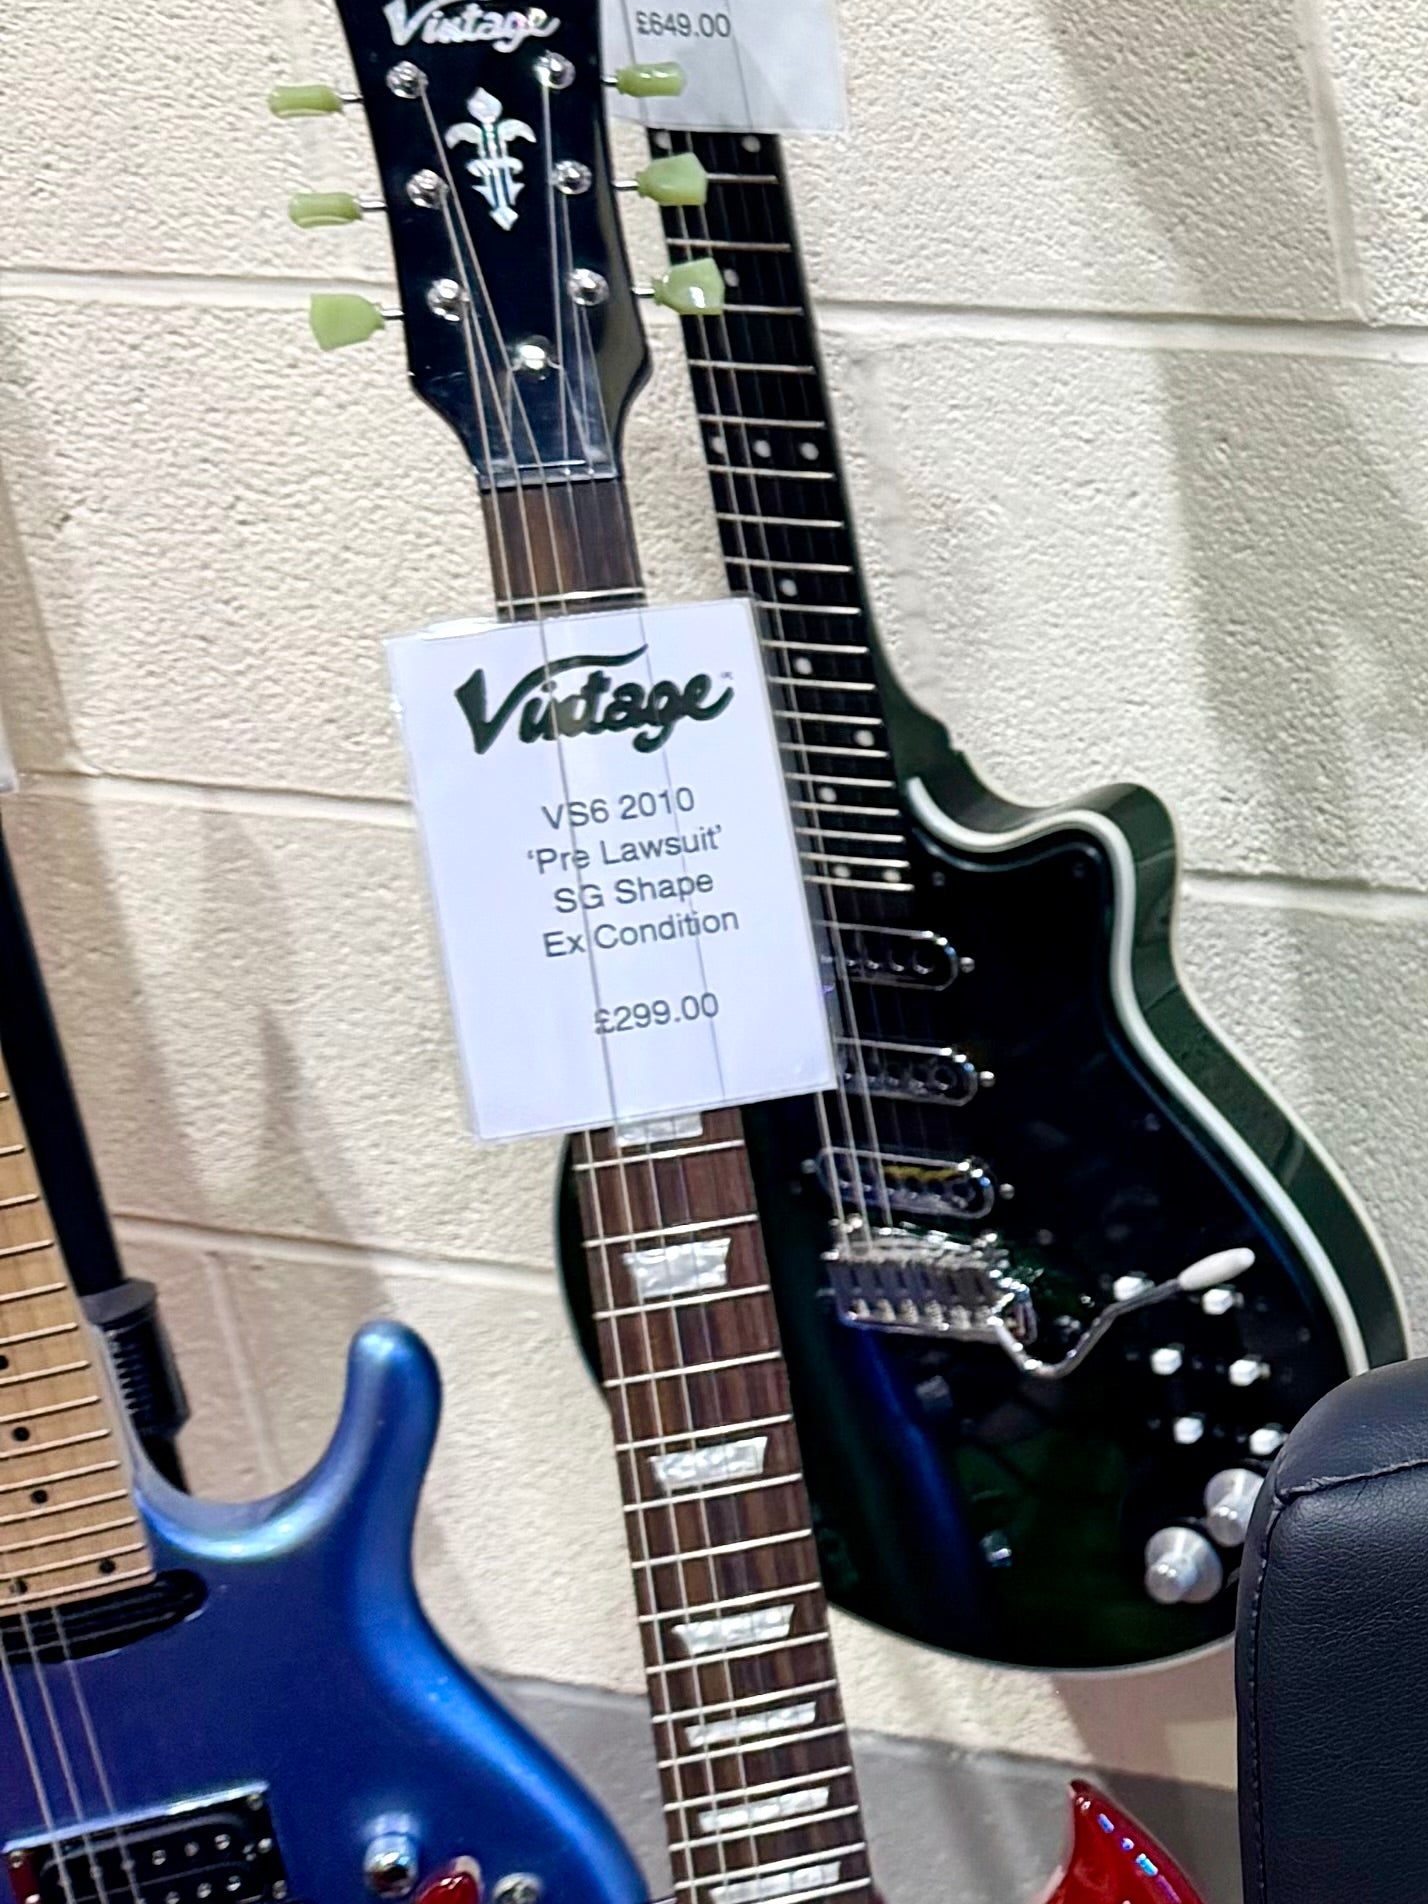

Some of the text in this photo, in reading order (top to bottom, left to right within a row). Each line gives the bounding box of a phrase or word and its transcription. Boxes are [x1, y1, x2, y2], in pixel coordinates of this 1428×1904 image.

[636, 10, 732, 38] £649.00
[454, 643, 734, 755] Vintage
[541, 787, 695, 830] VS6 2010
[554, 873, 714, 914] SG Shape
[542, 911, 740, 958] Ex Condition
[594, 992, 719, 1035] £299.00
